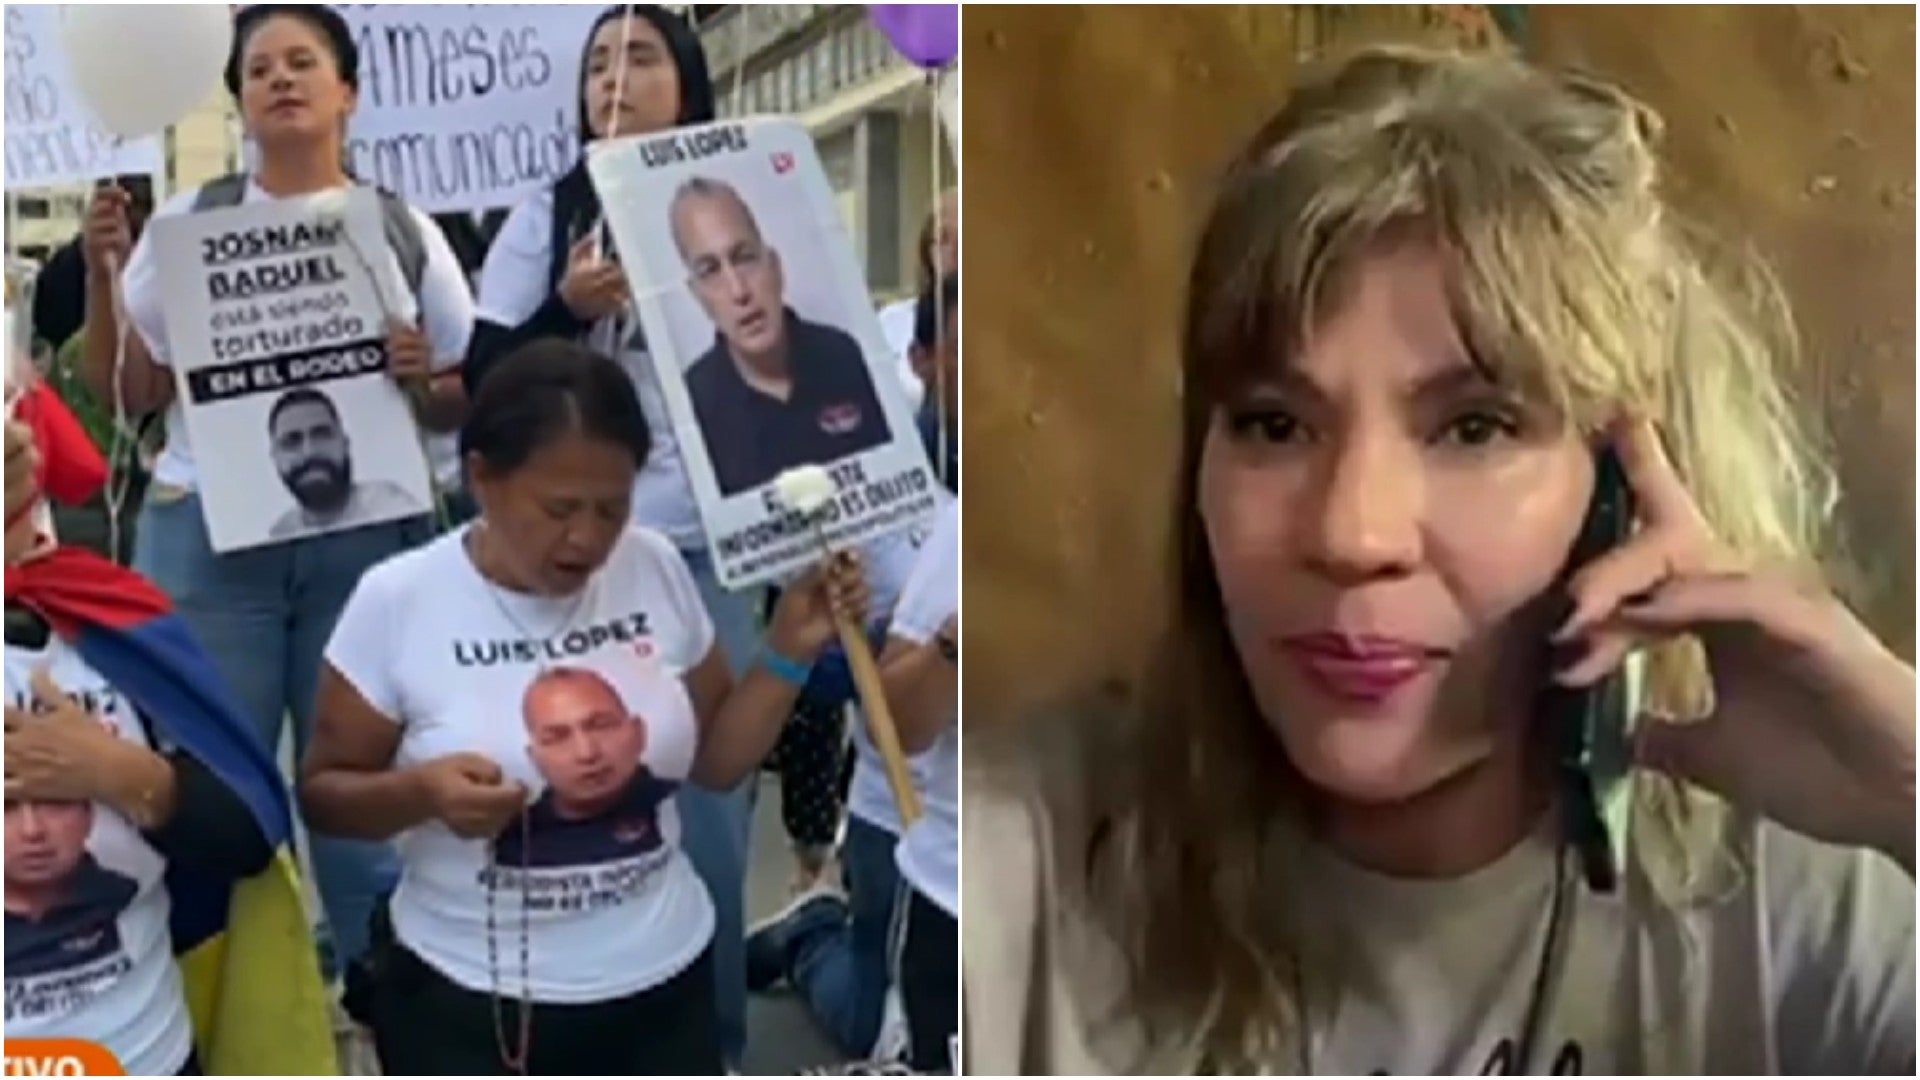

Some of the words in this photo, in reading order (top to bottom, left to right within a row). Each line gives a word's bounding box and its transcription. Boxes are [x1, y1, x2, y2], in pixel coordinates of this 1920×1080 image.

[207, 254, 348, 302] BADUEL
[211, 313, 364, 361] torturado
[208, 370, 251, 394] EN
[252, 362, 285, 388] EL
[453, 639, 537, 667] LUIS
[541, 612, 652, 660] LOPEZ
